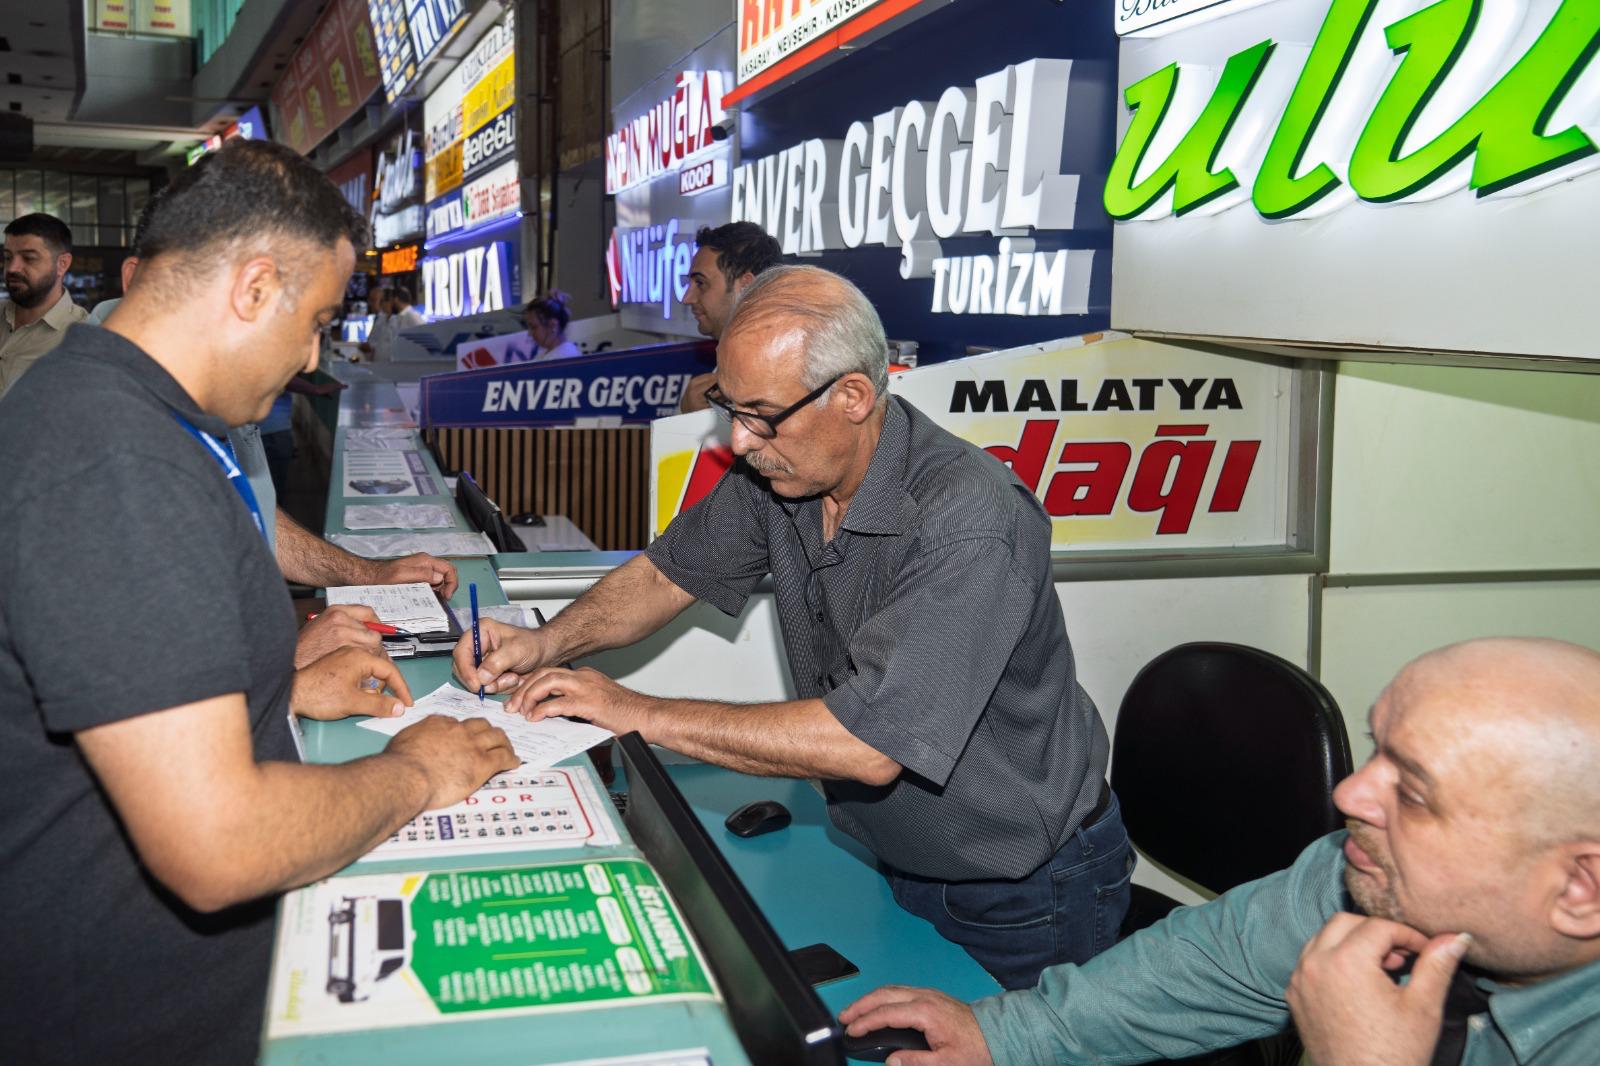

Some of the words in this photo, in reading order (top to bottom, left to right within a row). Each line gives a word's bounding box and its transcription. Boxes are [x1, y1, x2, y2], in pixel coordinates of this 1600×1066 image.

[681, 164, 712, 193] KOOP
[730, 137, 827, 256] ENVER
[838, 58, 1050, 280] GEÇGEL
[422, 241, 504, 318] TRUVA
[621, 218, 700, 319] Nilüfe
[931, 237, 1070, 316] TURİZM
[481, 377, 583, 413] ENVER
[949, 378, 1243, 413] MALATYA
[636, 884, 688, 960] İSTANBUL
